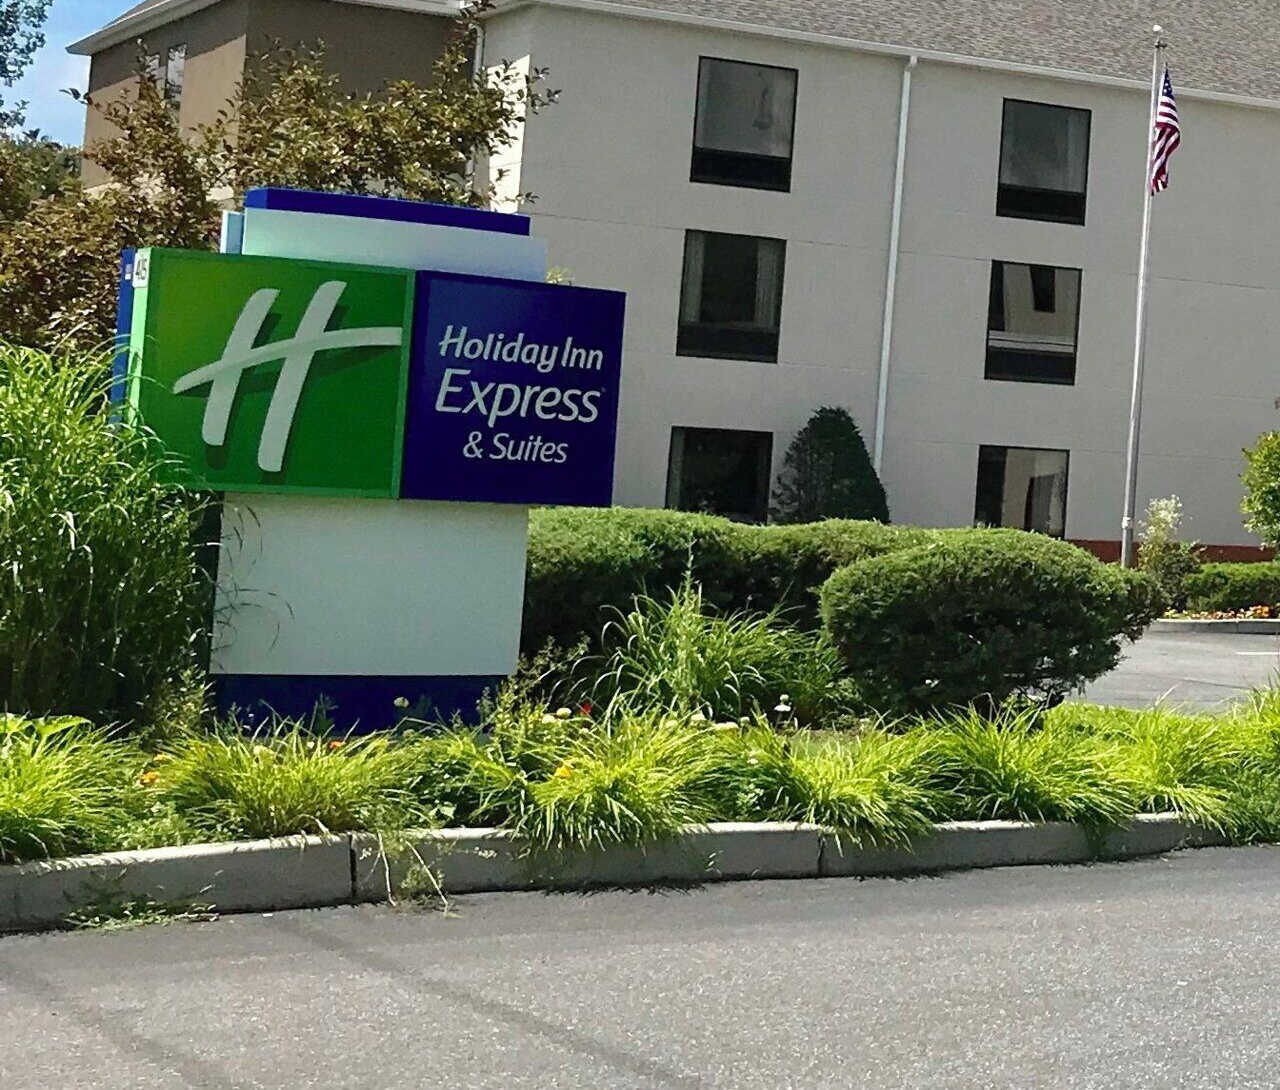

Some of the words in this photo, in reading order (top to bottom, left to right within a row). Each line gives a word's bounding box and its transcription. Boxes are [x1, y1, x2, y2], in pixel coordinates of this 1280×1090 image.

[438, 325, 559, 373] Holiday
[561, 336, 604, 370] Inn
[435, 368, 601, 428] Express
[463, 431, 484, 459] &
[489, 432, 569, 463] Suites
